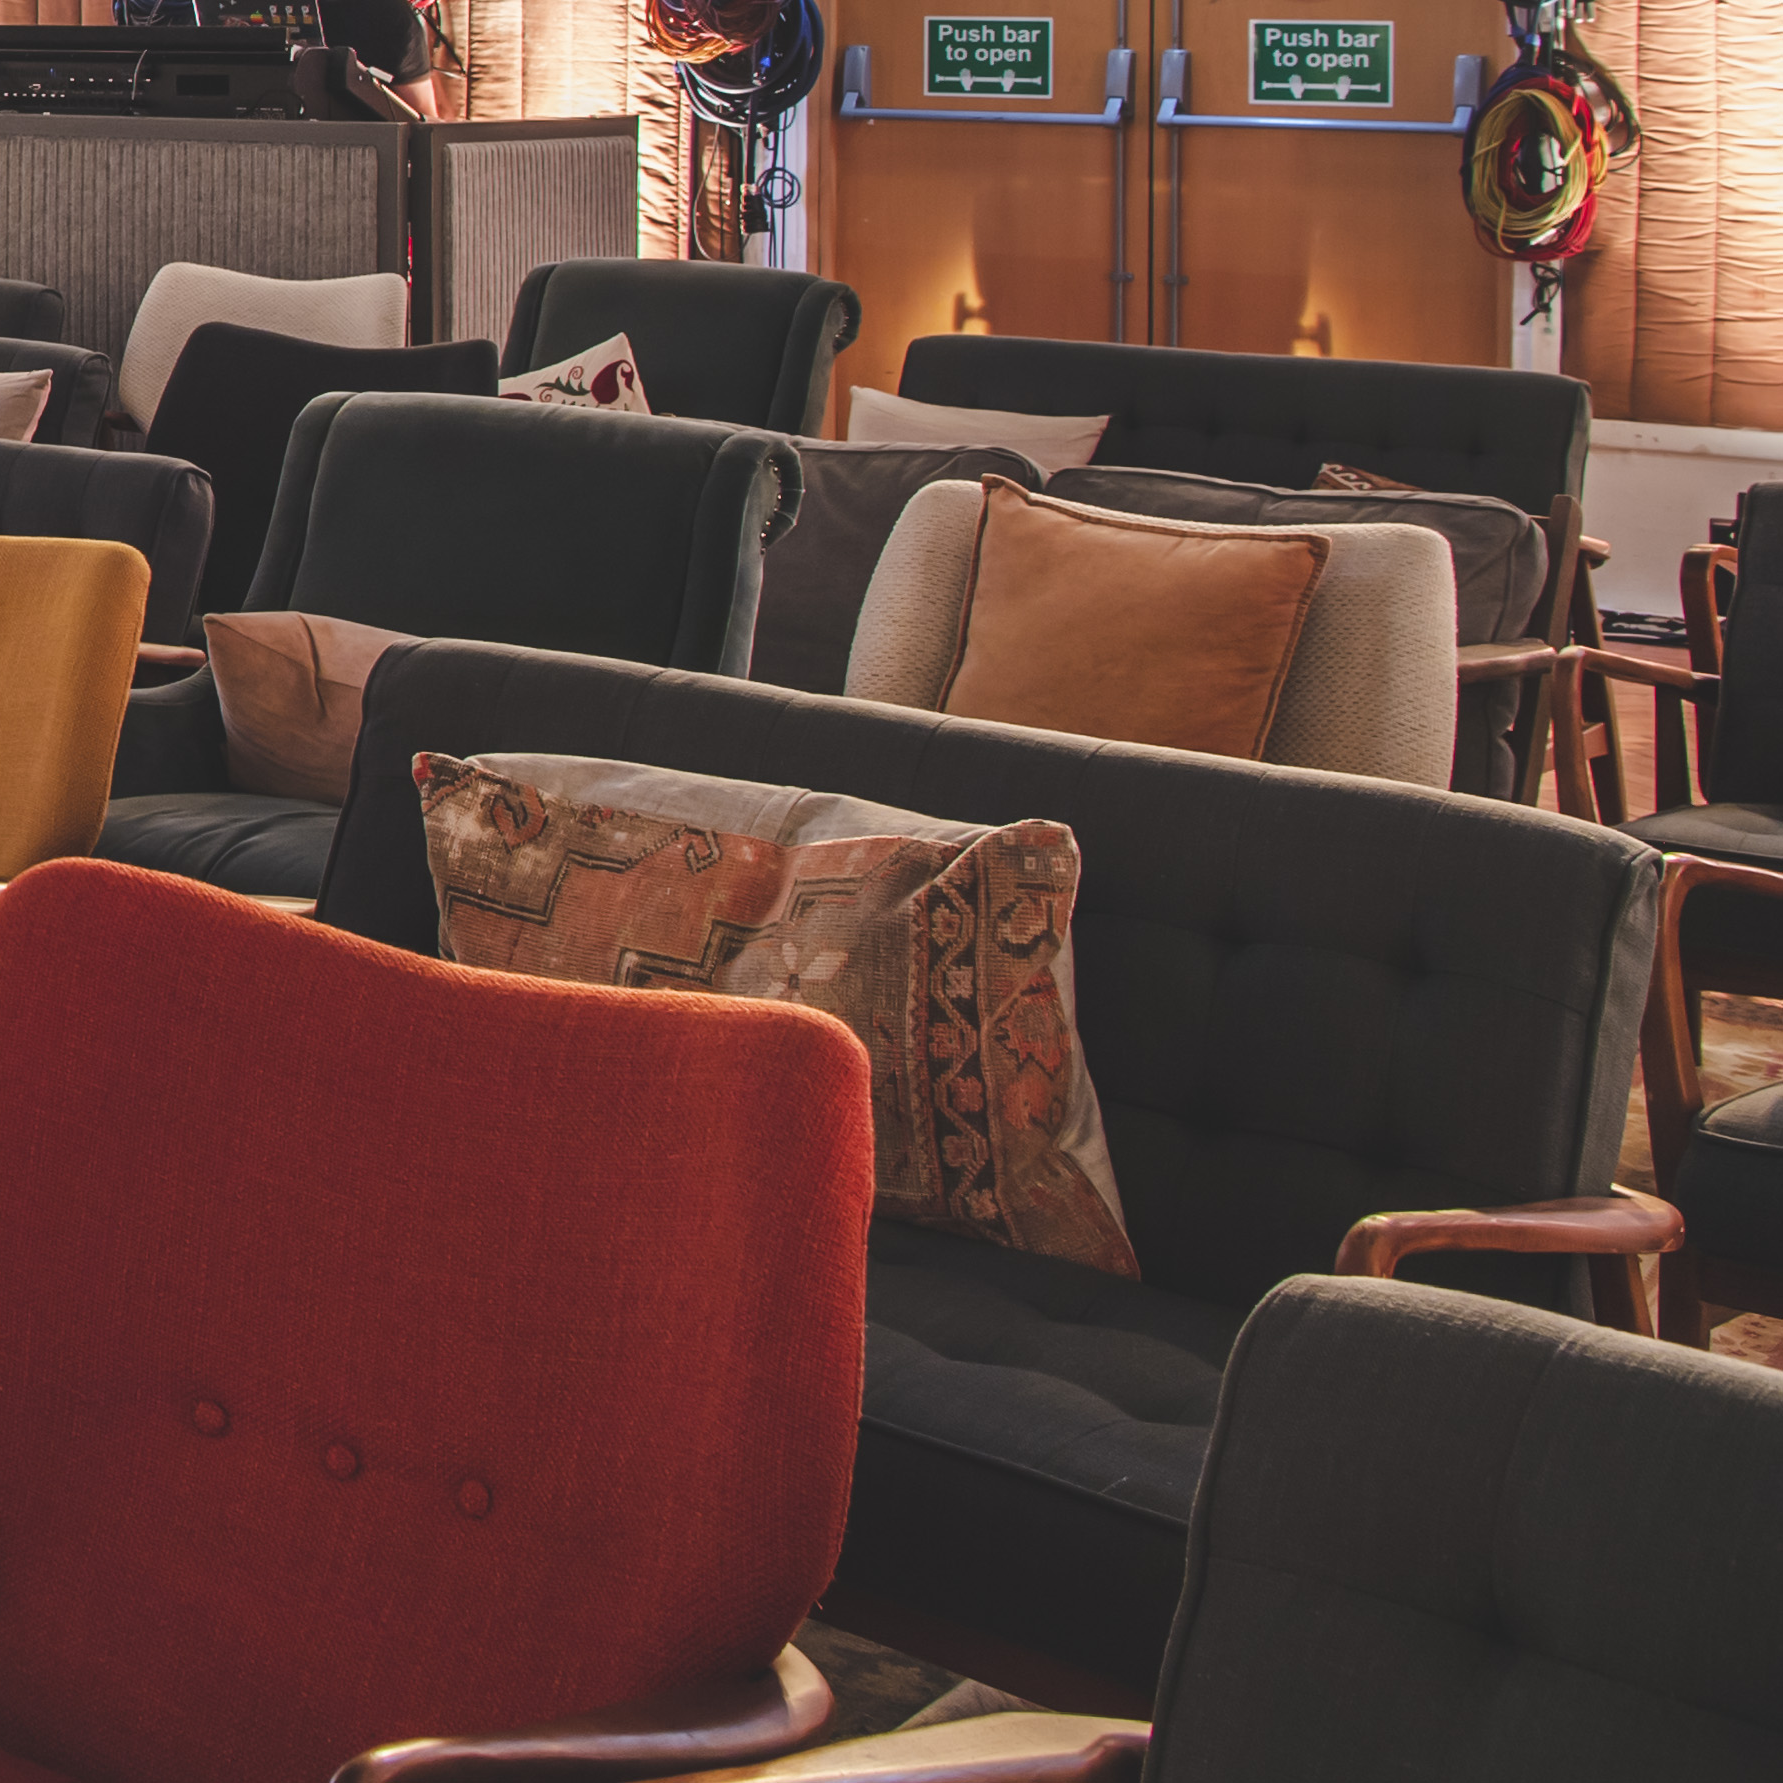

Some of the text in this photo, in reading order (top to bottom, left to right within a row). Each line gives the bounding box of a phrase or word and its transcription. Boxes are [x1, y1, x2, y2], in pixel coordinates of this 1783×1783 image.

[938, 24, 1041, 43] Push bar
[1264, 27, 1380, 48] Push bar
[944, 44, 1032, 66] to open
[1272, 48, 1370, 72] to open
